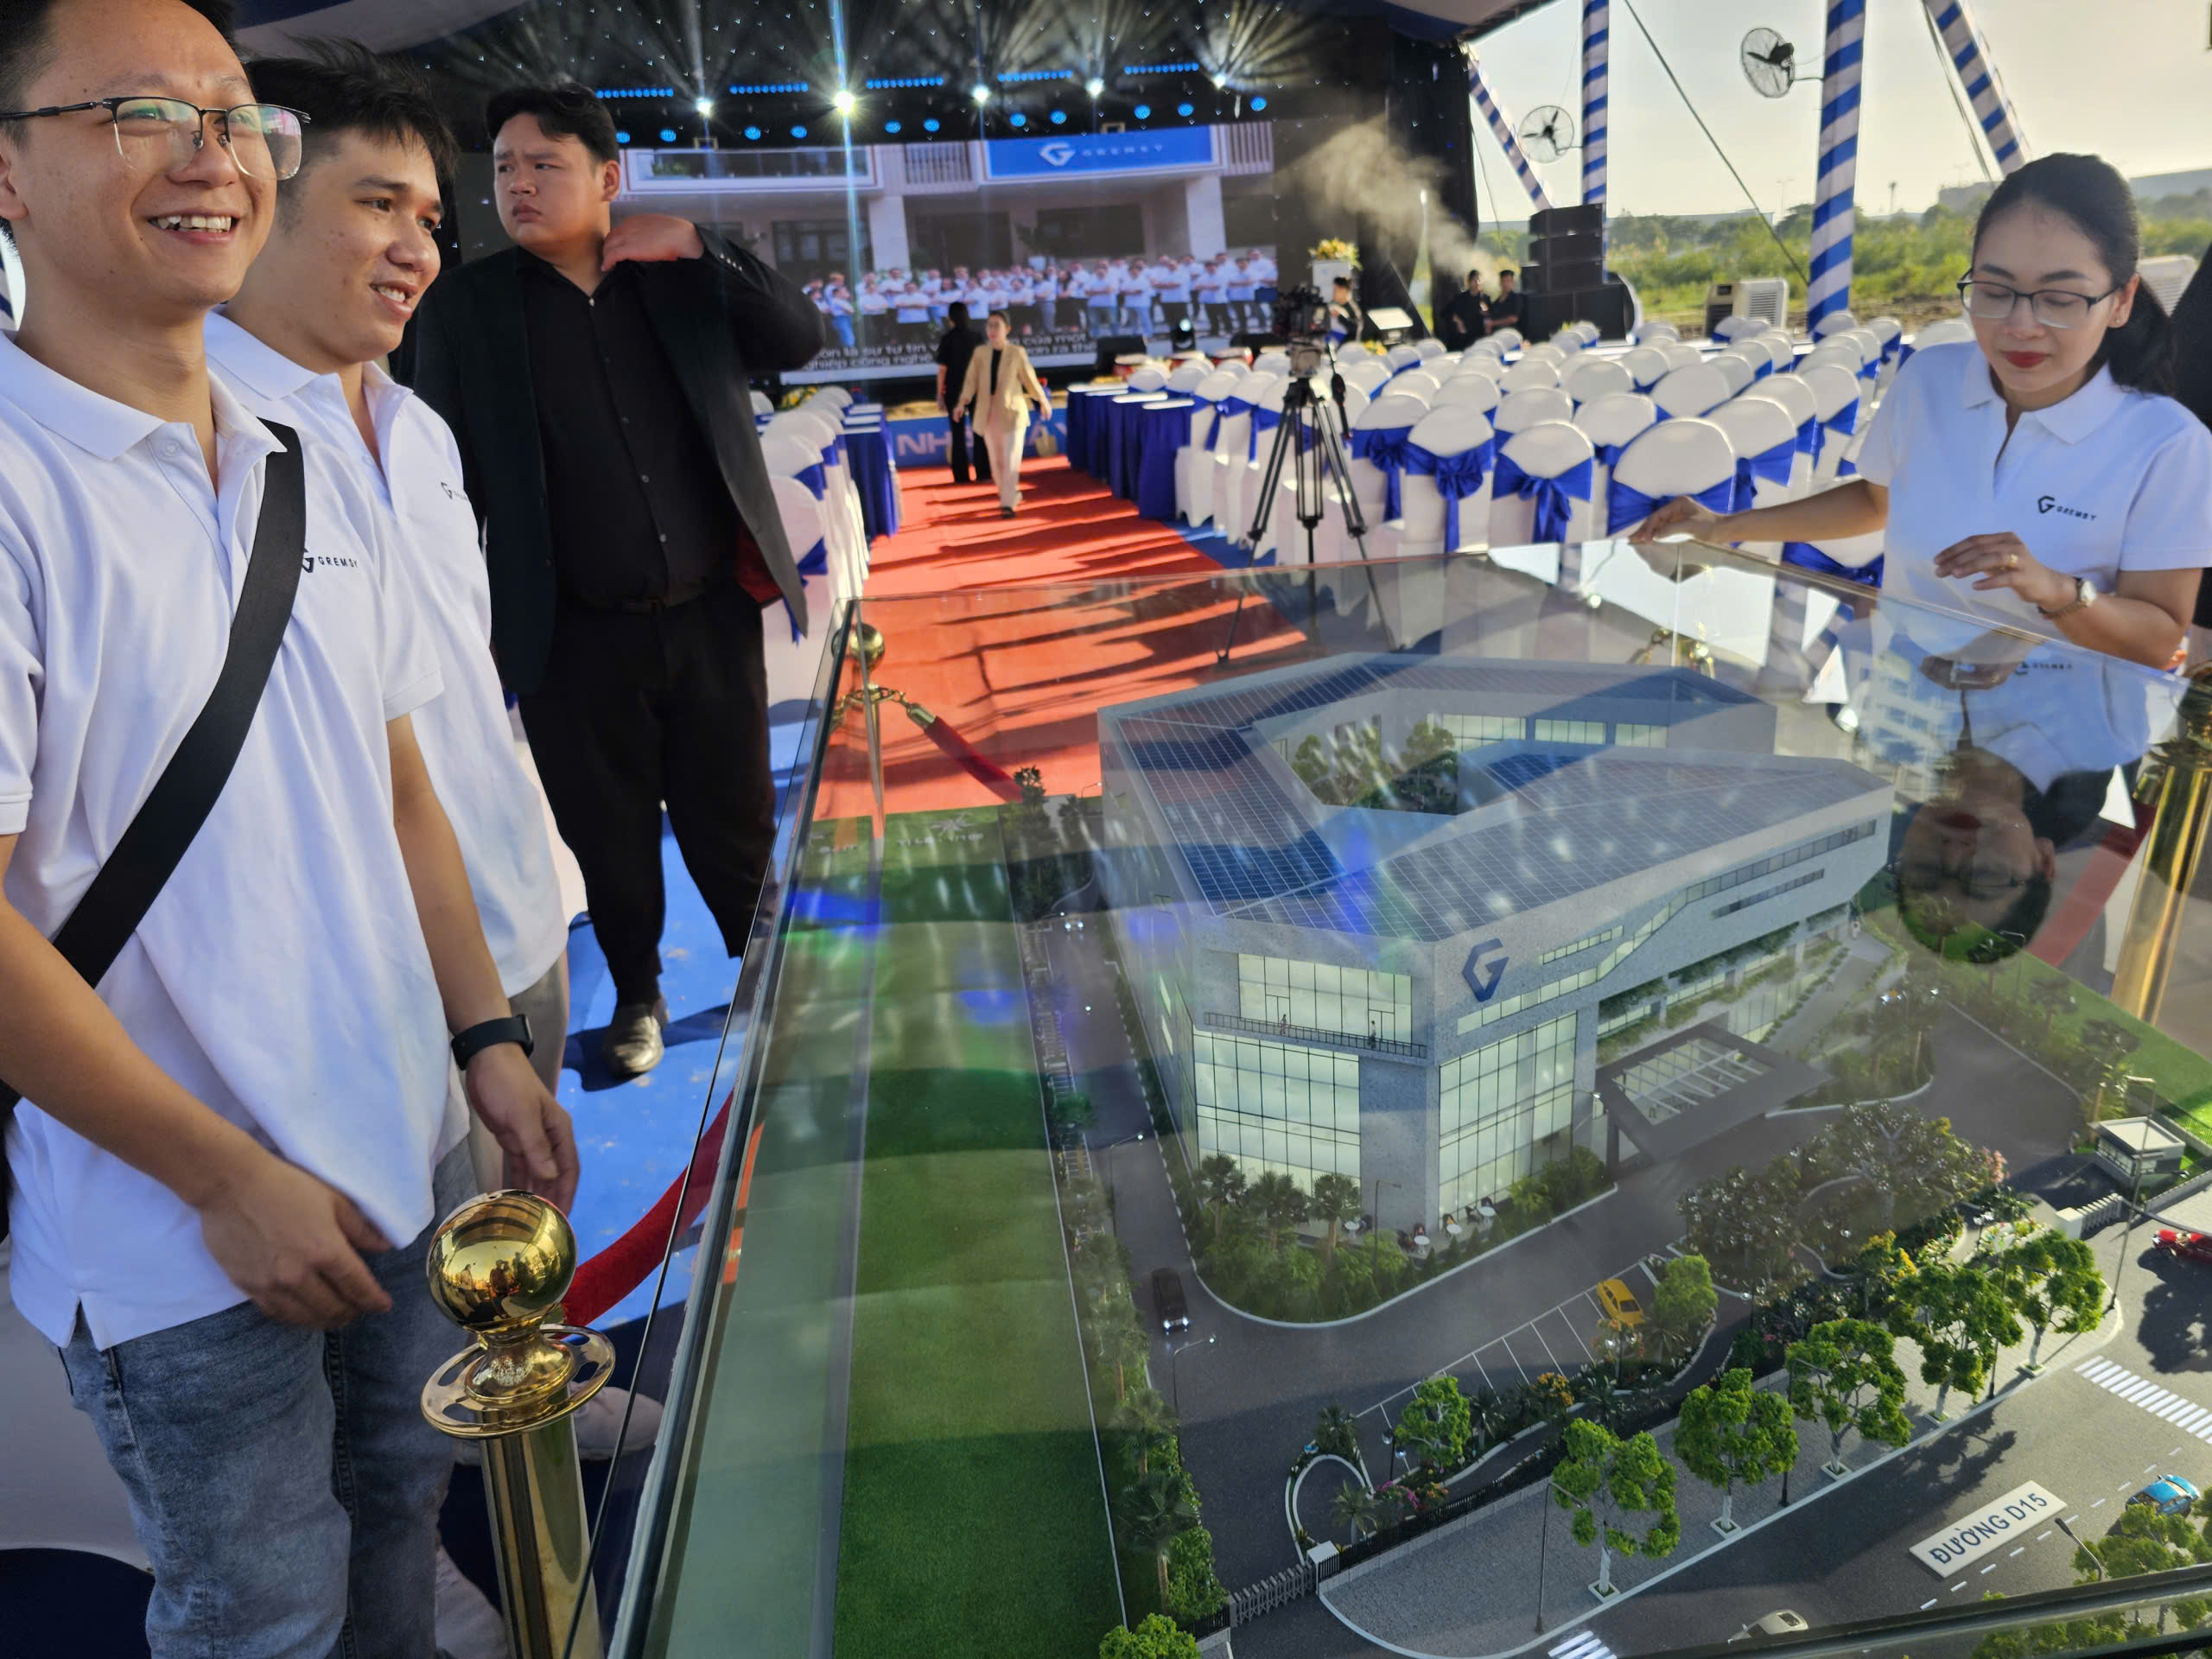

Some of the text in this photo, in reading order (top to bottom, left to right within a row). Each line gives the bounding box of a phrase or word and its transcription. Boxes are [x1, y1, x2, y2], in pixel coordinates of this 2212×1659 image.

[317, 556, 359, 568] GREMSY
[1929, 1493, 2048, 1564] ĐƯỜNG D15
